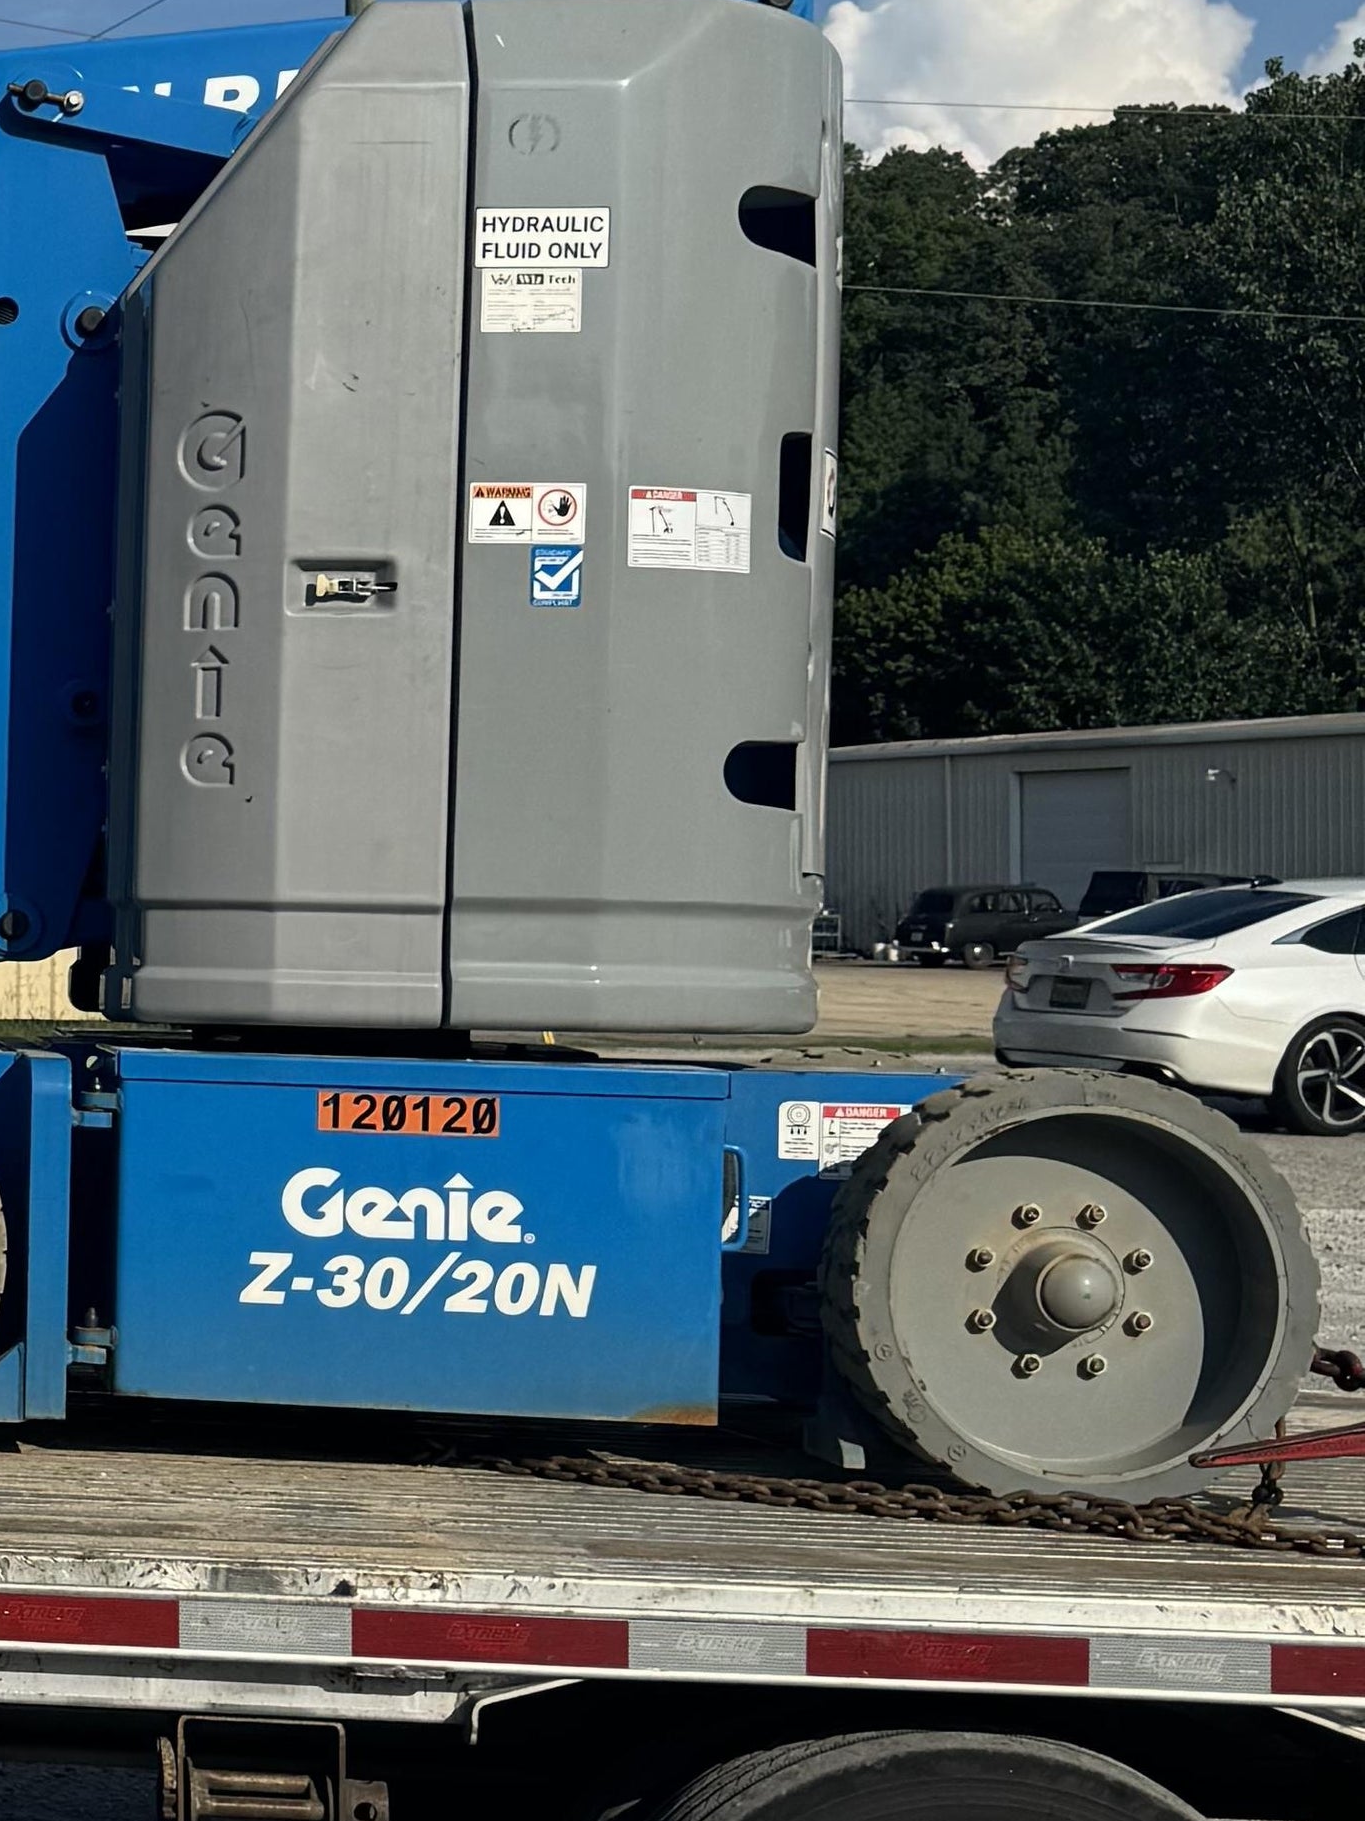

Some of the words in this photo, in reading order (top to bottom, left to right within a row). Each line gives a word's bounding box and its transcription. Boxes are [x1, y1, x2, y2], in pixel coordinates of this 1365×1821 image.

[482, 216, 604, 232] HYDRAULIC
[481, 242, 541, 259] FLUID
[548, 241, 602, 259] ONLY
[321, 1094, 497, 1135] 120120
[281, 1166, 525, 1243] Genie
[239, 1251, 597, 1318] Z-30/20N
